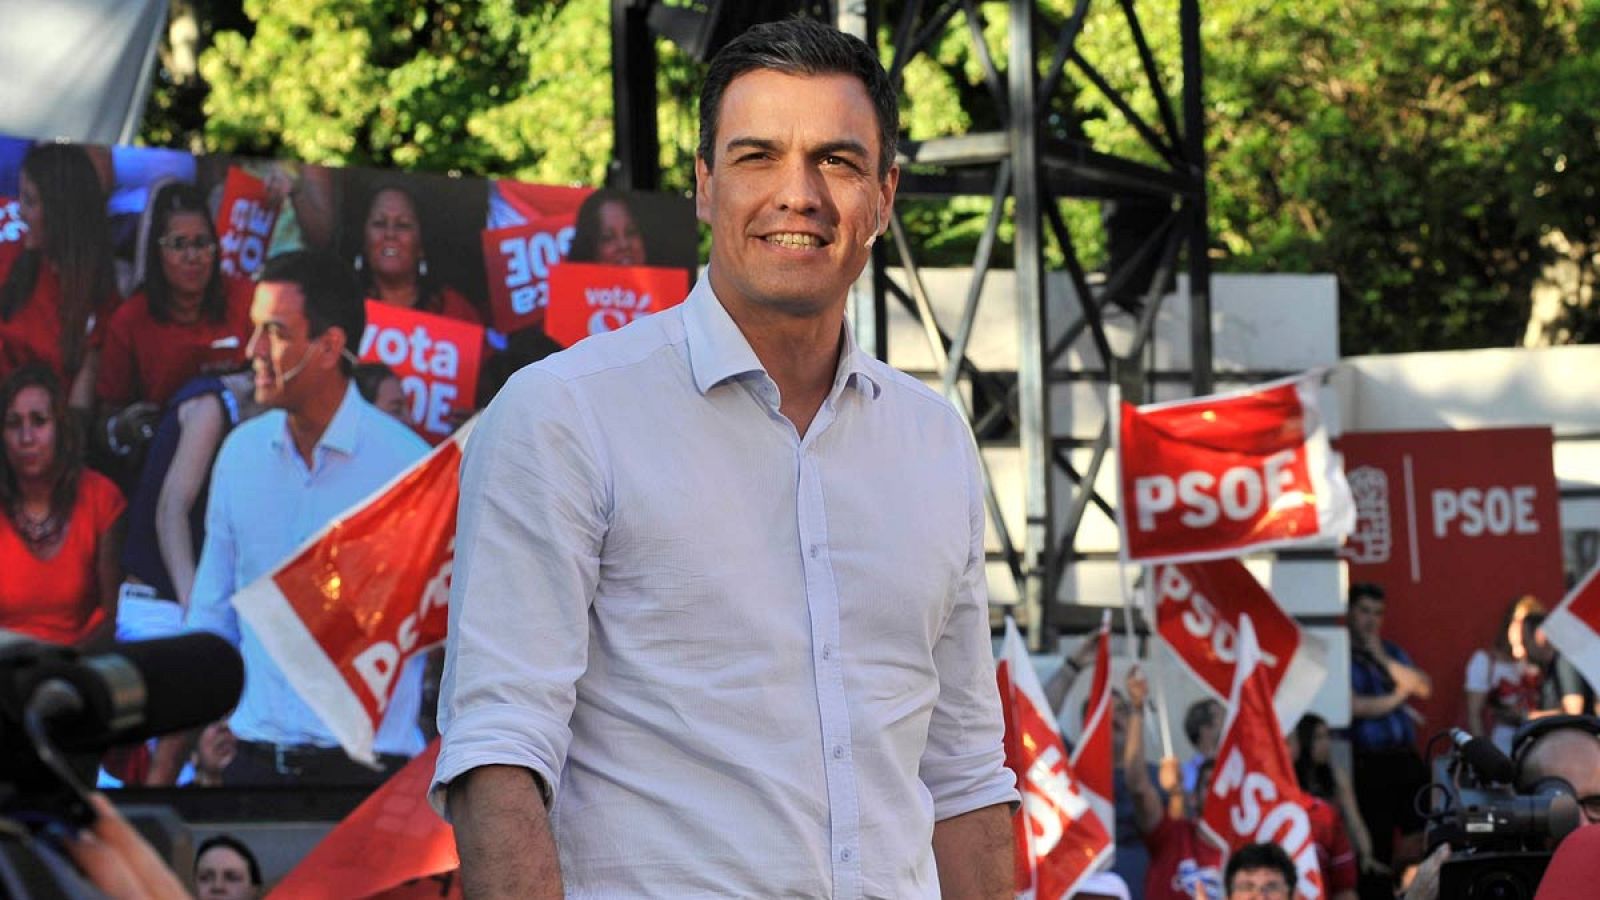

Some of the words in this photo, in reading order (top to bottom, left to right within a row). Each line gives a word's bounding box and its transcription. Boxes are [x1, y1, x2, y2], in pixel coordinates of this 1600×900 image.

[401, 375, 459, 434] OE
[1134, 449, 1305, 531] PSOE
[1432, 486, 1539, 538] PSOE
[1156, 564, 1278, 668] PSO
[1020, 745, 1091, 857] OE
